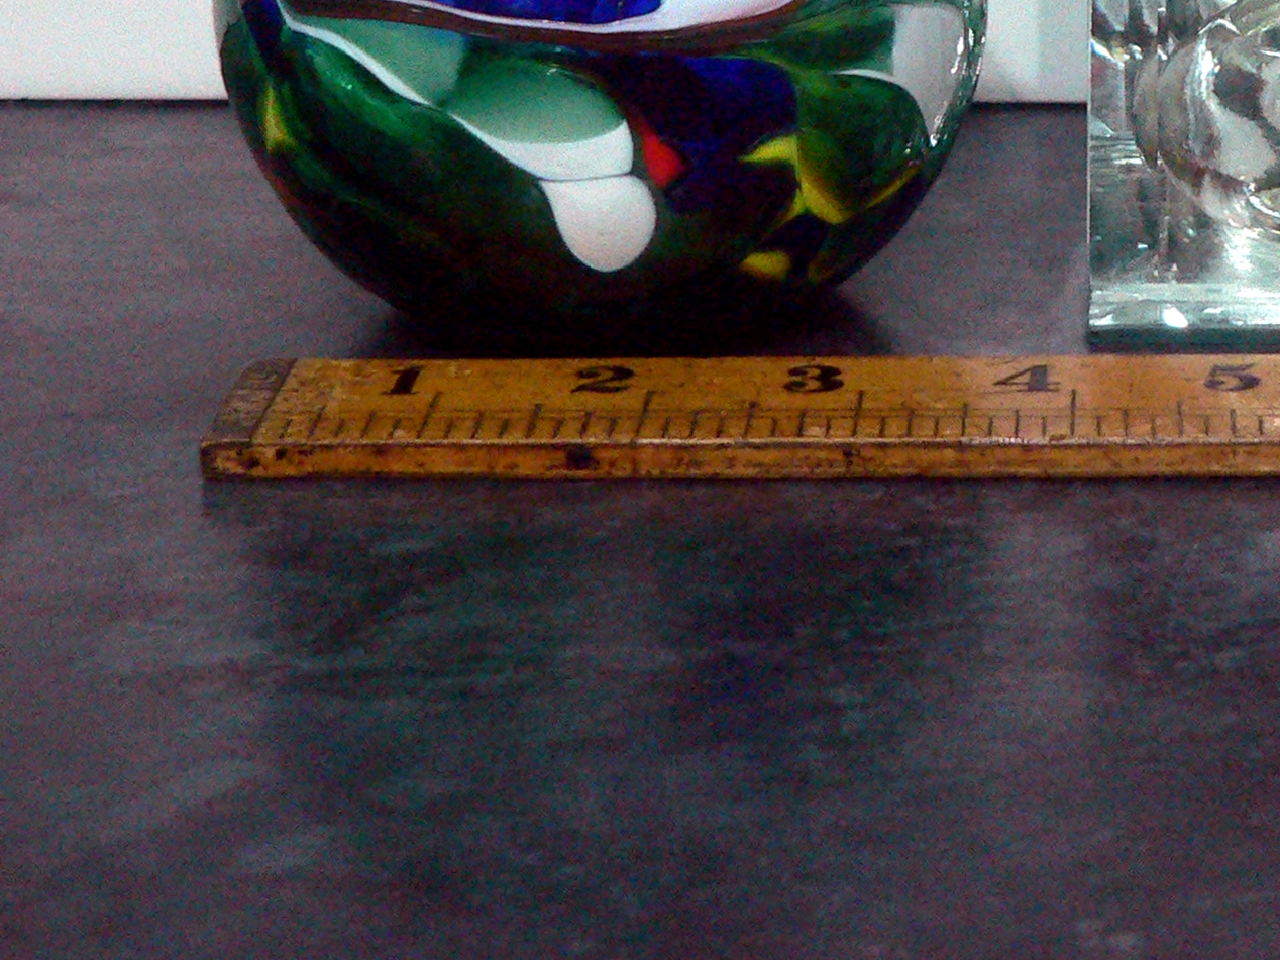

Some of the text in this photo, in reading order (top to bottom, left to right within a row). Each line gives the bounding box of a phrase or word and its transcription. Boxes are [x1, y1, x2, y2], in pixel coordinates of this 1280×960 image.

[383, 365, 426, 396] 1
[570, 365, 636, 394] 2
[782, 364, 845, 393] 3
[993, 363, 1061, 393] 4
[1203, 362, 1263, 392] 5
